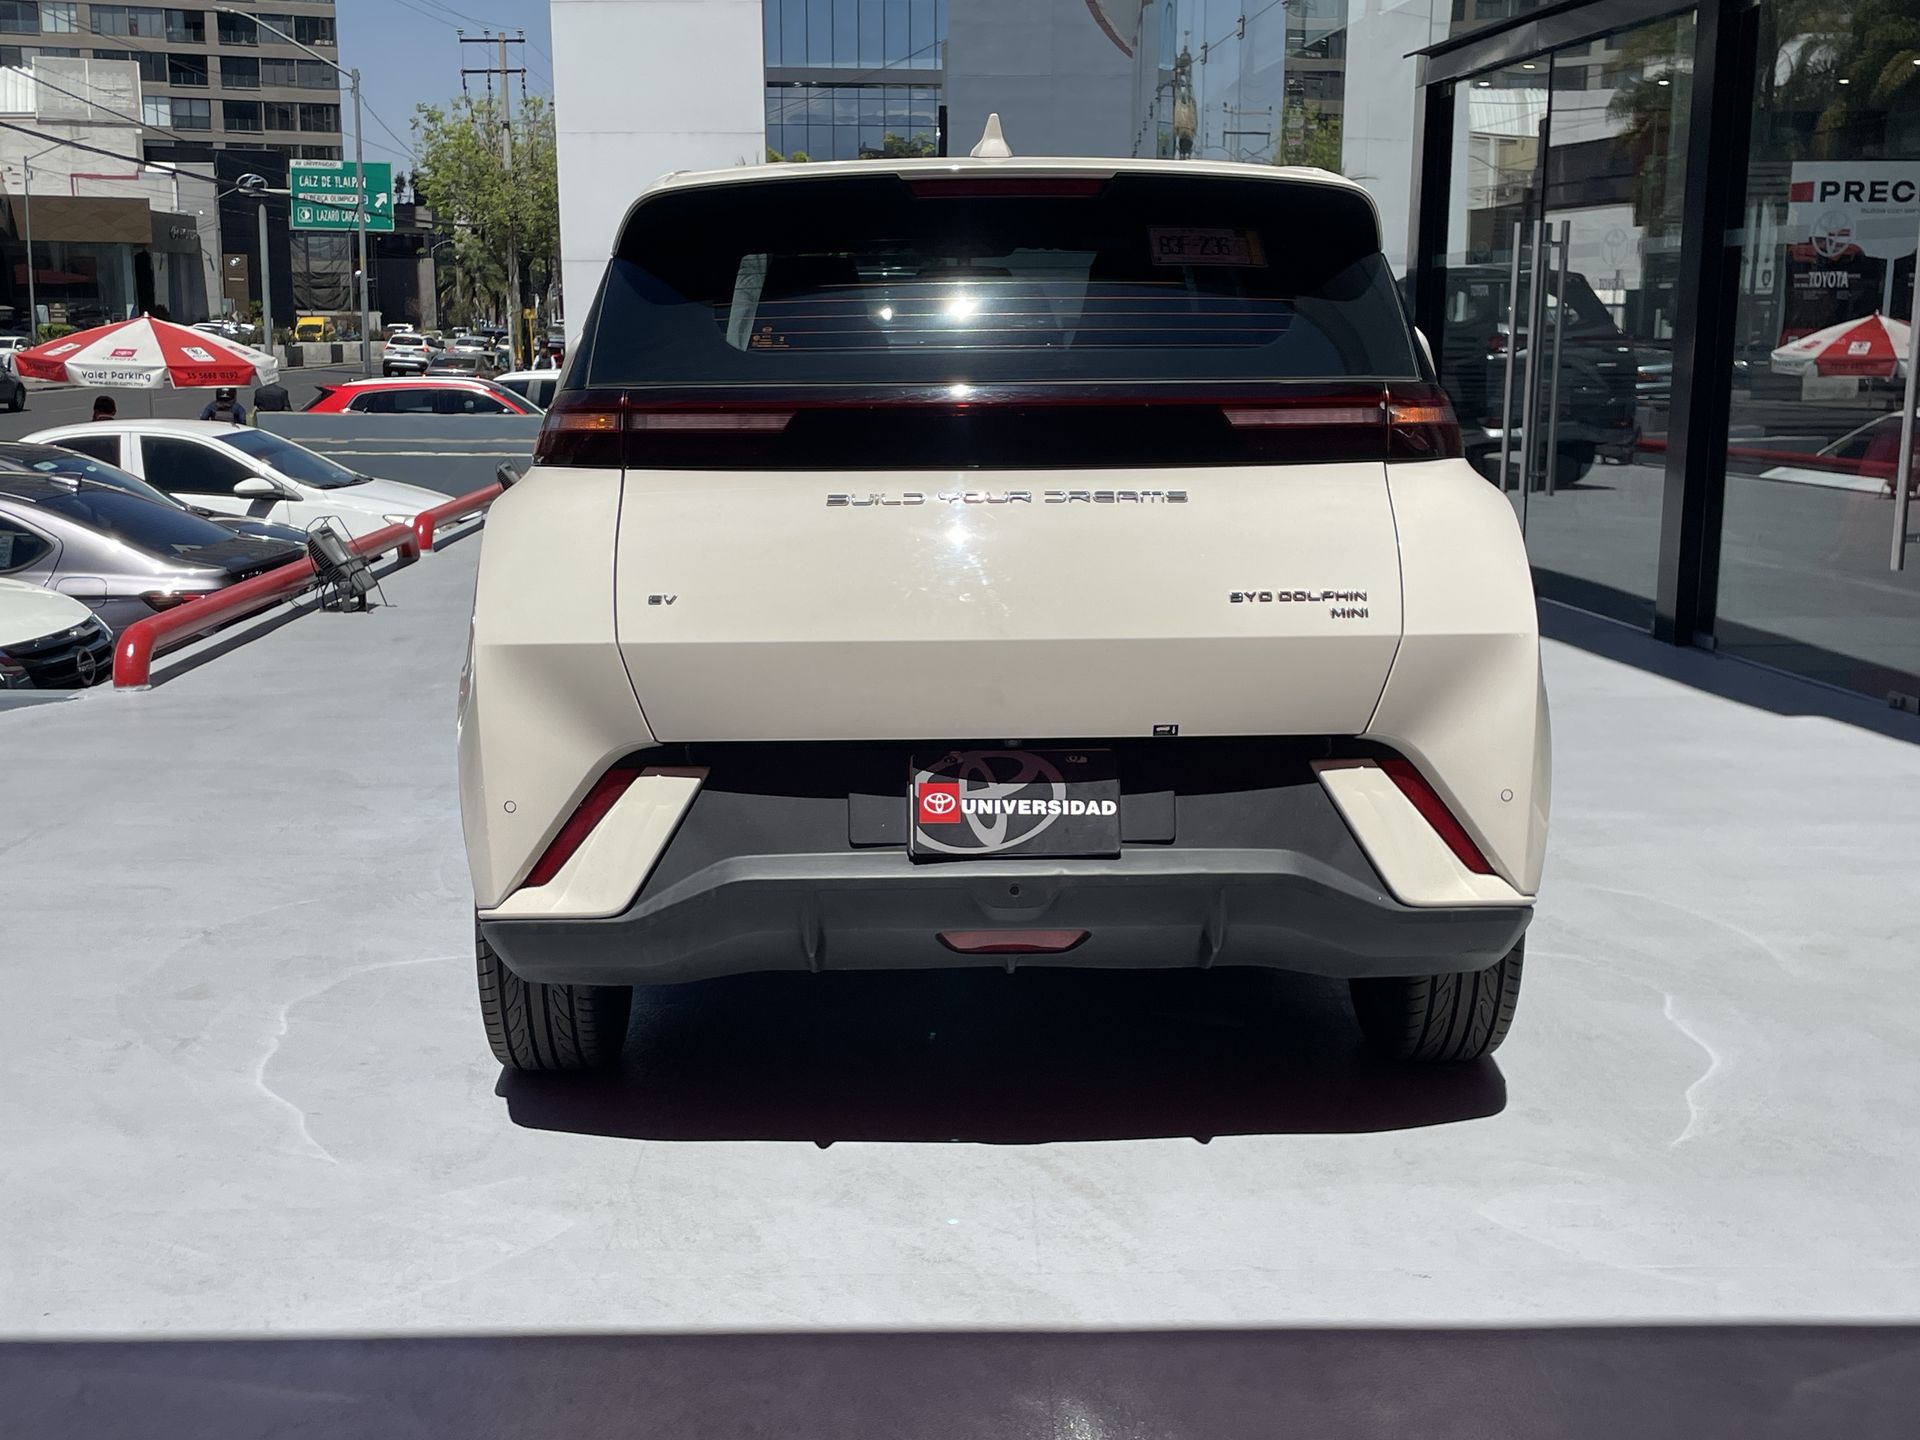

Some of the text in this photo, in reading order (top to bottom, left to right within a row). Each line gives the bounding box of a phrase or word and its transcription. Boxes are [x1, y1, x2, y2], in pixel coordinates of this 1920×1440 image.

[299, 175, 319, 187] CALZ
[321, 175, 332, 187] DE
[1820, 180, 1920, 203] PREC
[316, 209, 340, 222] LAZARO
[1808, 271, 1849, 288] TOYOTA
[81, 371, 152, 383] Valet Parking
[826, 490, 1188, 507] BUILD YOUR DREAMS
[648, 594, 678, 606] EV
[1229, 590, 1368, 603] BYD DOLPHIN
[1331, 607, 1369, 619] MINI
[960, 798, 1118, 816] UNIVERSIDAD
